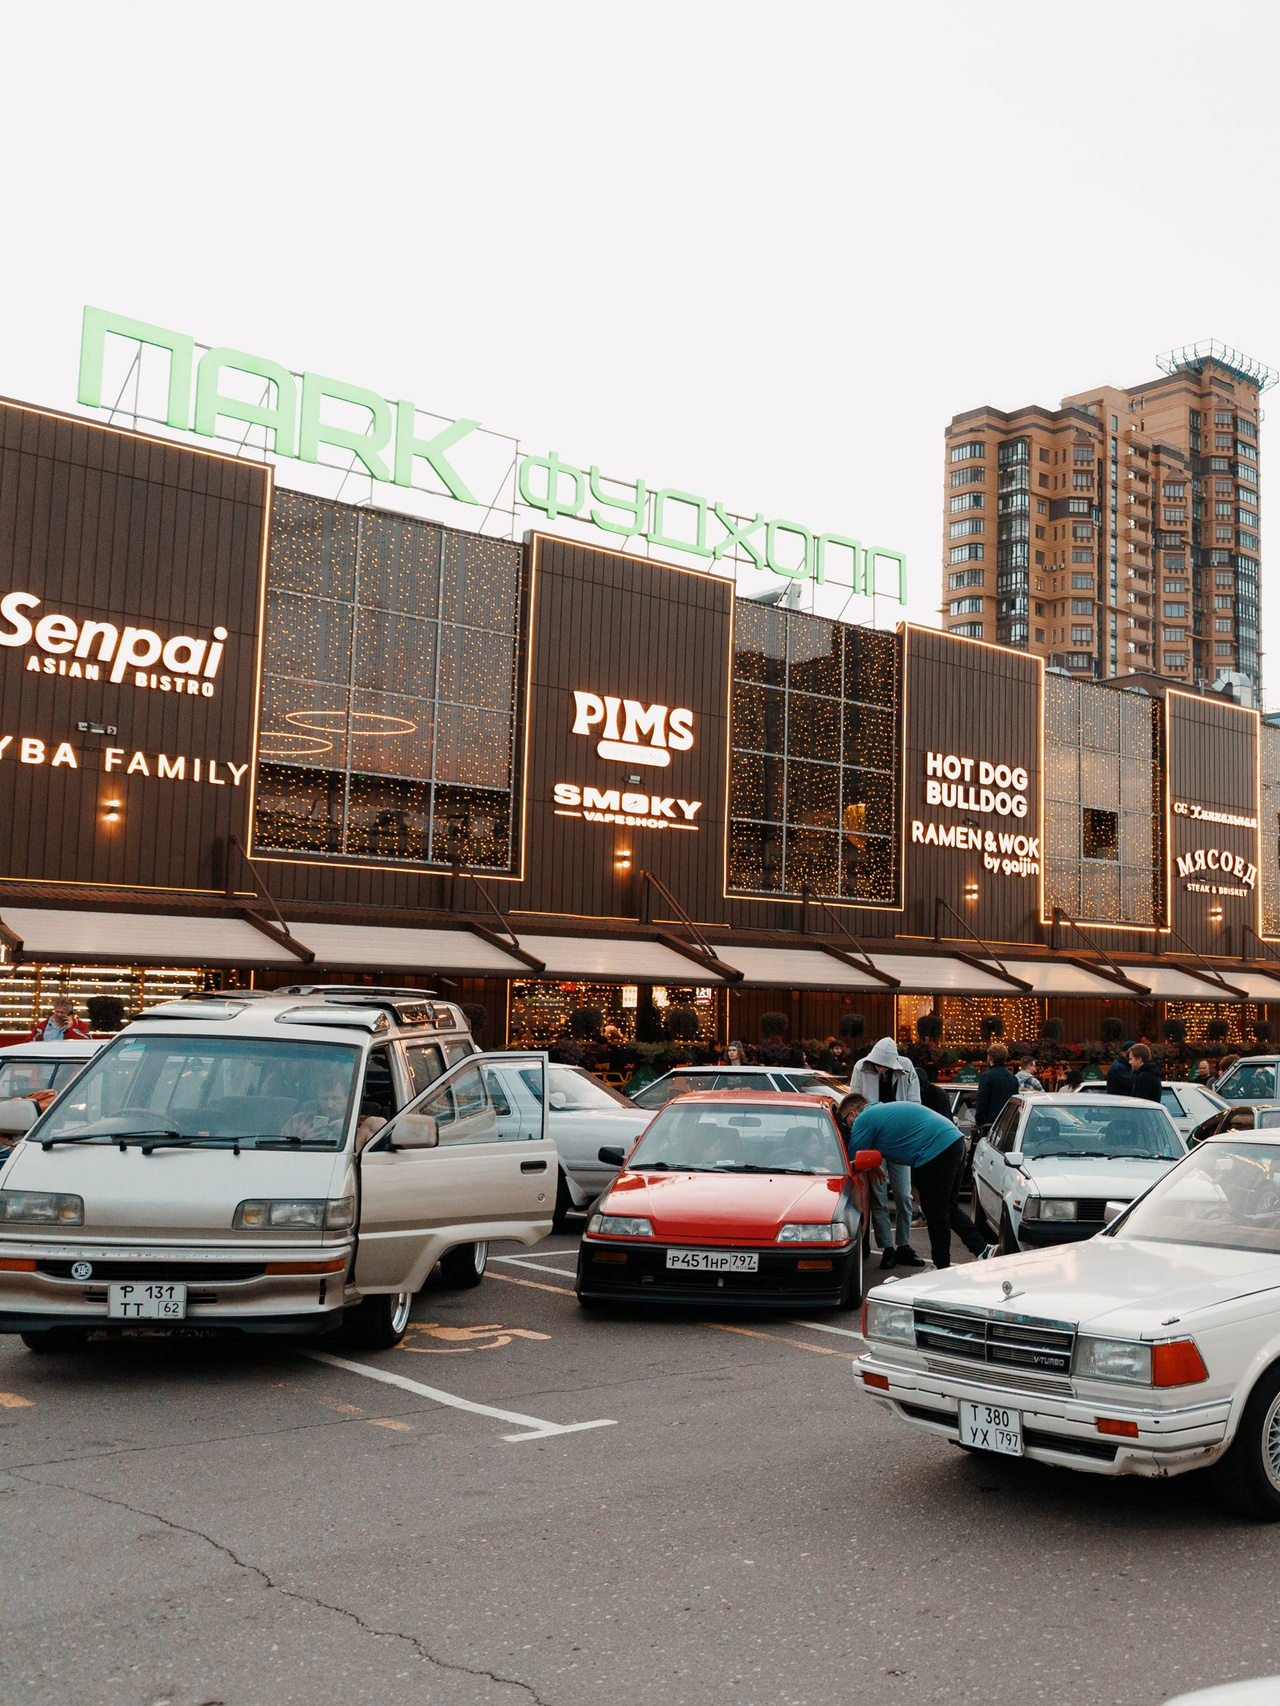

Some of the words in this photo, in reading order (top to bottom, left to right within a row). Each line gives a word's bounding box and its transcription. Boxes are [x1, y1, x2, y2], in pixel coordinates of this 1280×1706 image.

[0, 592, 228, 684] Senpai
[26, 655, 99, 681] ASIAN
[135, 671, 214, 698] BISTRO
[572, 690, 694, 751] PIMS
[104, 748, 249, 786] FAMILY
[926, 751, 974, 780] HOT
[979, 761, 1028, 791] DOG
[554, 784, 702, 820] SMOKY
[926, 780, 1028, 818] BULLDOG
[583, 811, 669, 829] VAPESHOP
[911, 820, 982, 851] RAMEN
[998, 832, 1040, 858] WOK
[983, 852, 1001, 873] by
[1001, 857, 1040, 877] gaijin
[1176, 849, 1258, 890] МЯСОЕД
[1187, 883, 1210, 894] STEAK
[1218, 886, 1248, 897] BRISKET
[732, 1255, 754, 1266] 797
[145, 1286, 174, 1299] 131
[164, 1303, 179, 1313] 62
[985, 1407, 1010, 1427] 380
[999, 1432, 1019, 1447] 797
